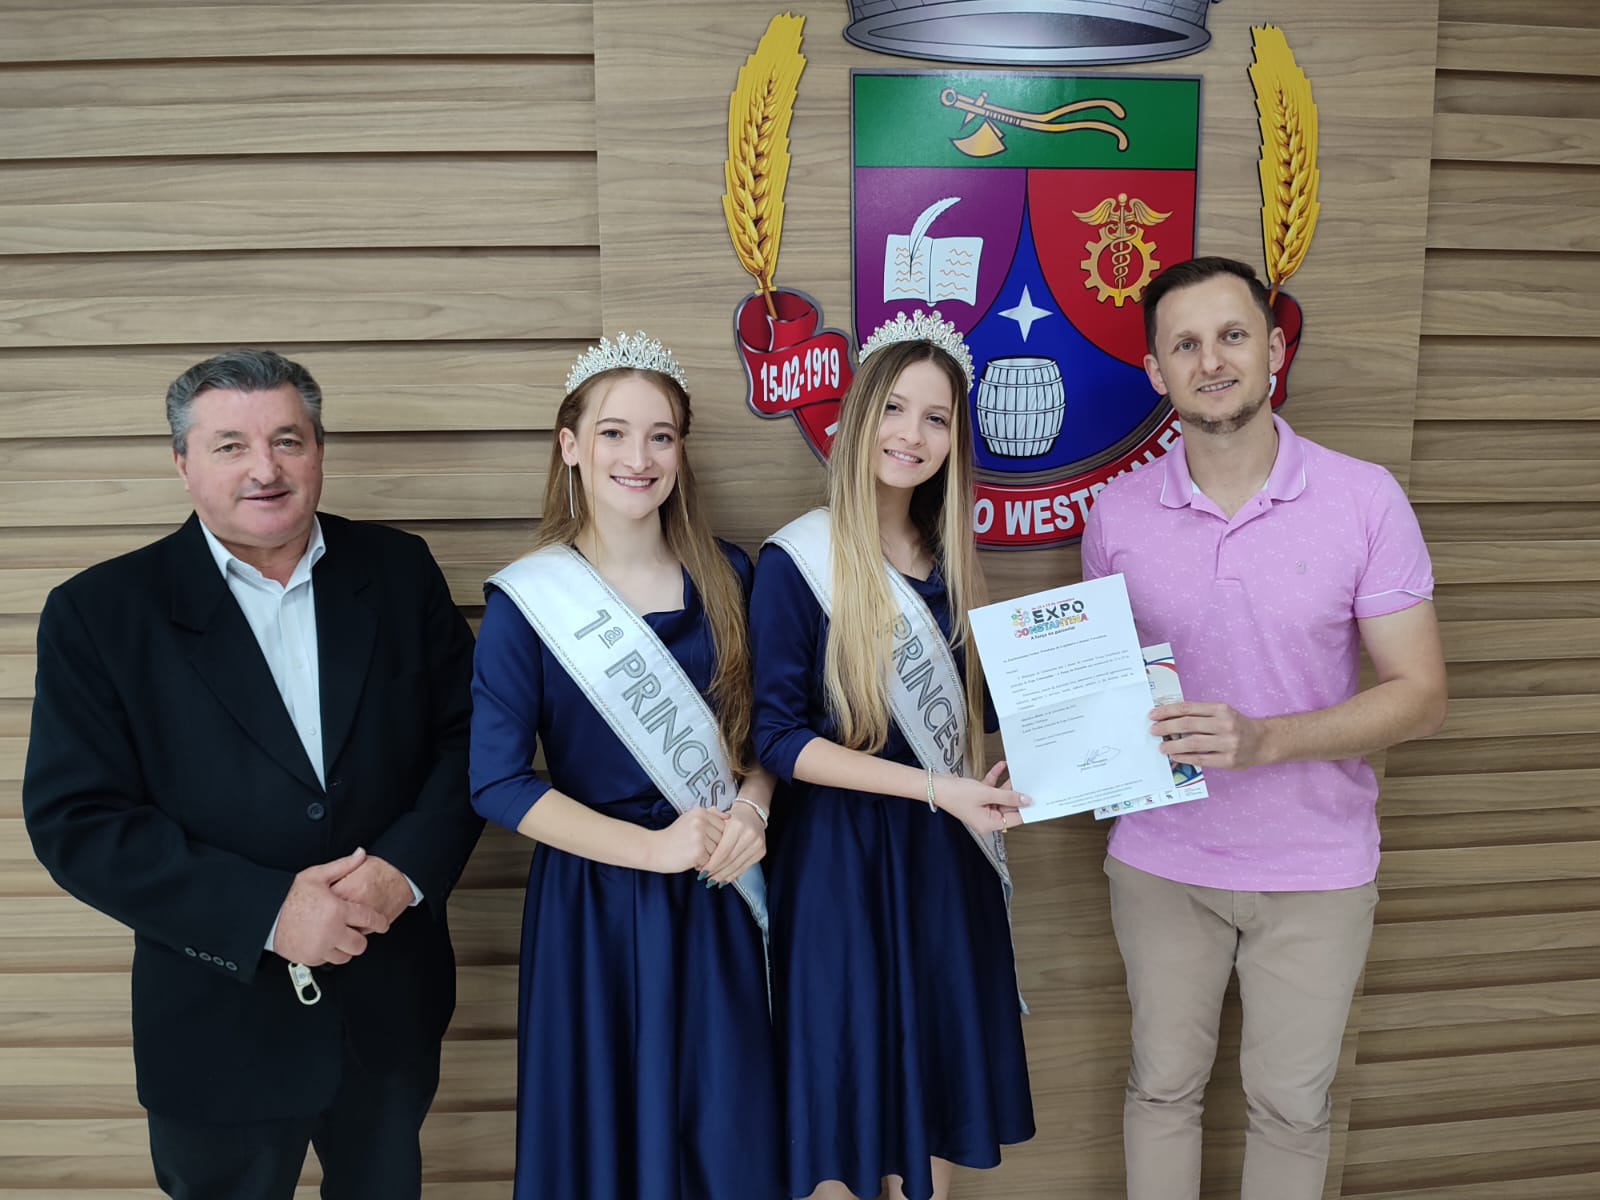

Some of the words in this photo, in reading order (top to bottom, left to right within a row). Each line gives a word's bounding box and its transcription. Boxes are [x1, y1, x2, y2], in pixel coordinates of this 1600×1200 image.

[761, 347, 840, 402] 15-02-1919
[1032, 600, 1084, 625] EXPO
[604, 649, 731, 812] PRINCES
